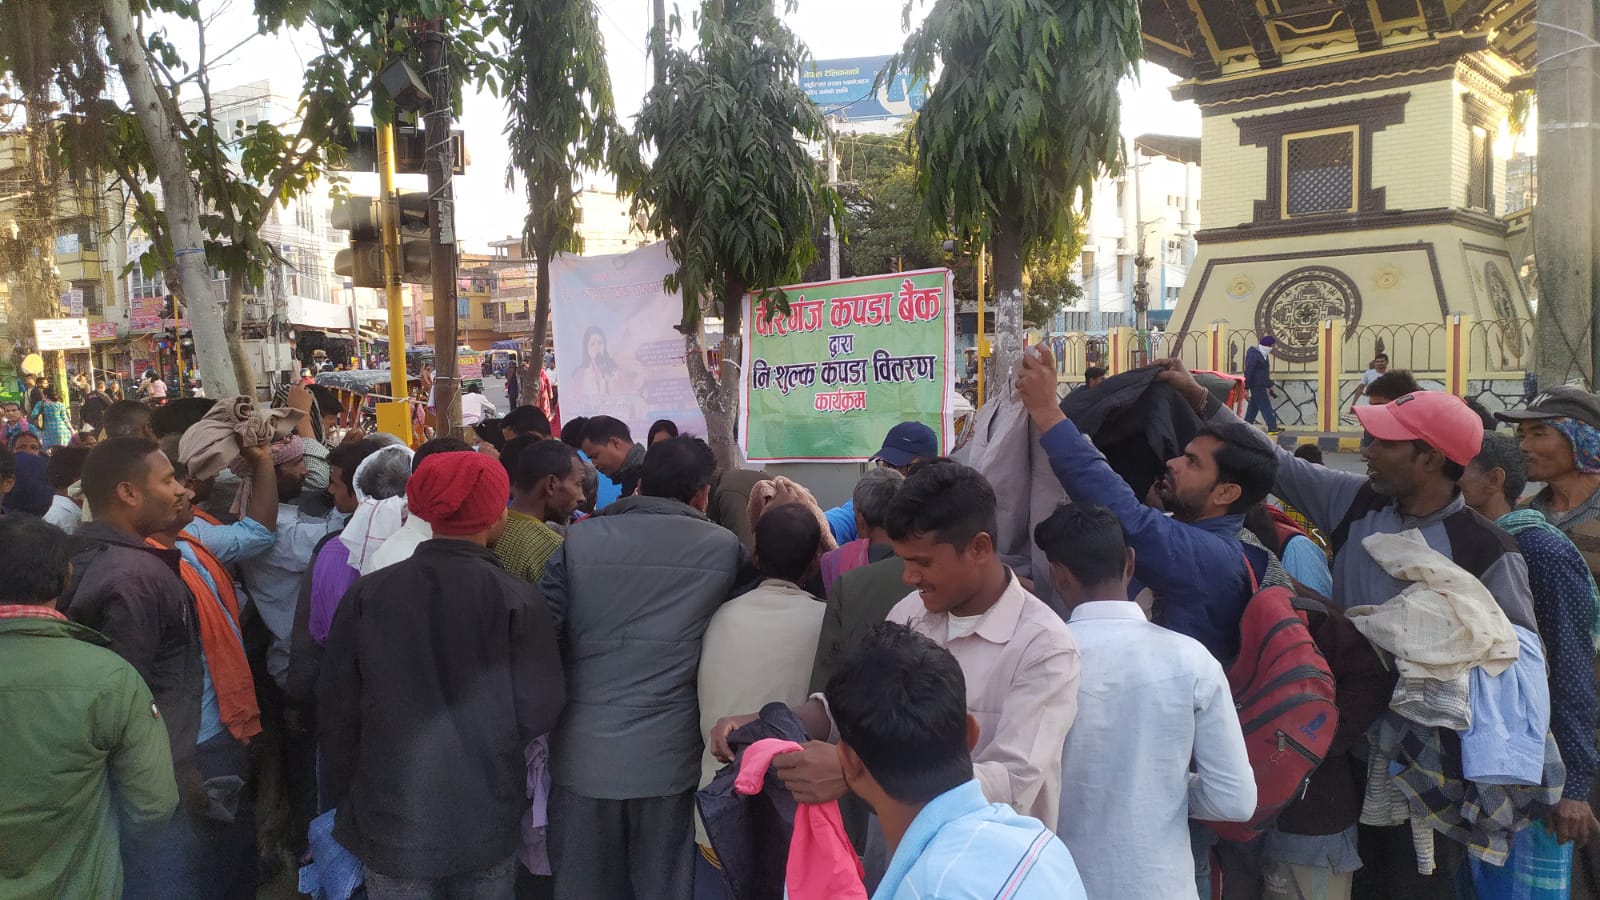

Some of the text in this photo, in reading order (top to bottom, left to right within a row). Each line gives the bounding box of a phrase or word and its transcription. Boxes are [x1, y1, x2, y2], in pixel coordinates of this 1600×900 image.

[830, 293, 893, 327] कपडा
[829, 334, 855, 358] द्वारा
[821, 359, 868, 386] कपडा
[873, 349, 936, 383] वितरण
[815, 388, 867, 414] कार्यक्रम
